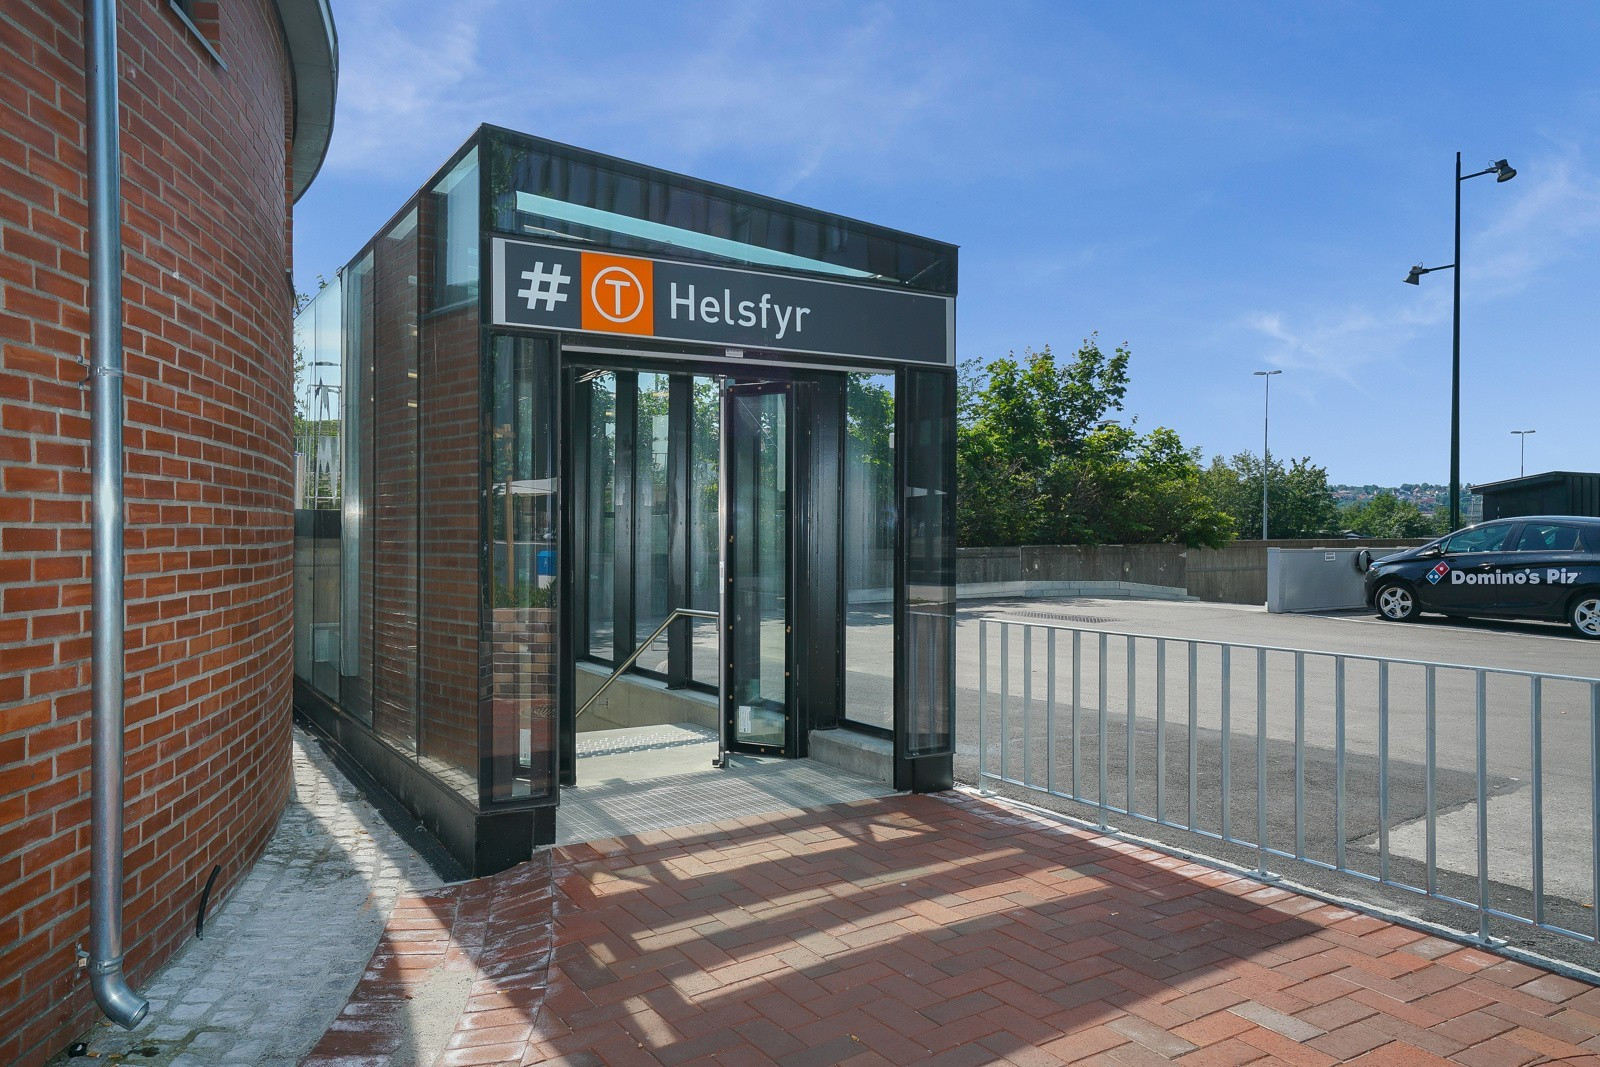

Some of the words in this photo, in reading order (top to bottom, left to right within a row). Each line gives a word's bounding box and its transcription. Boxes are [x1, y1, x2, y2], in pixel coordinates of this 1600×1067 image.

[670, 282, 811, 340] Helsfyr
[1451, 568, 1541, 585] Domino's
[1546, 567, 1581, 584] Piz
